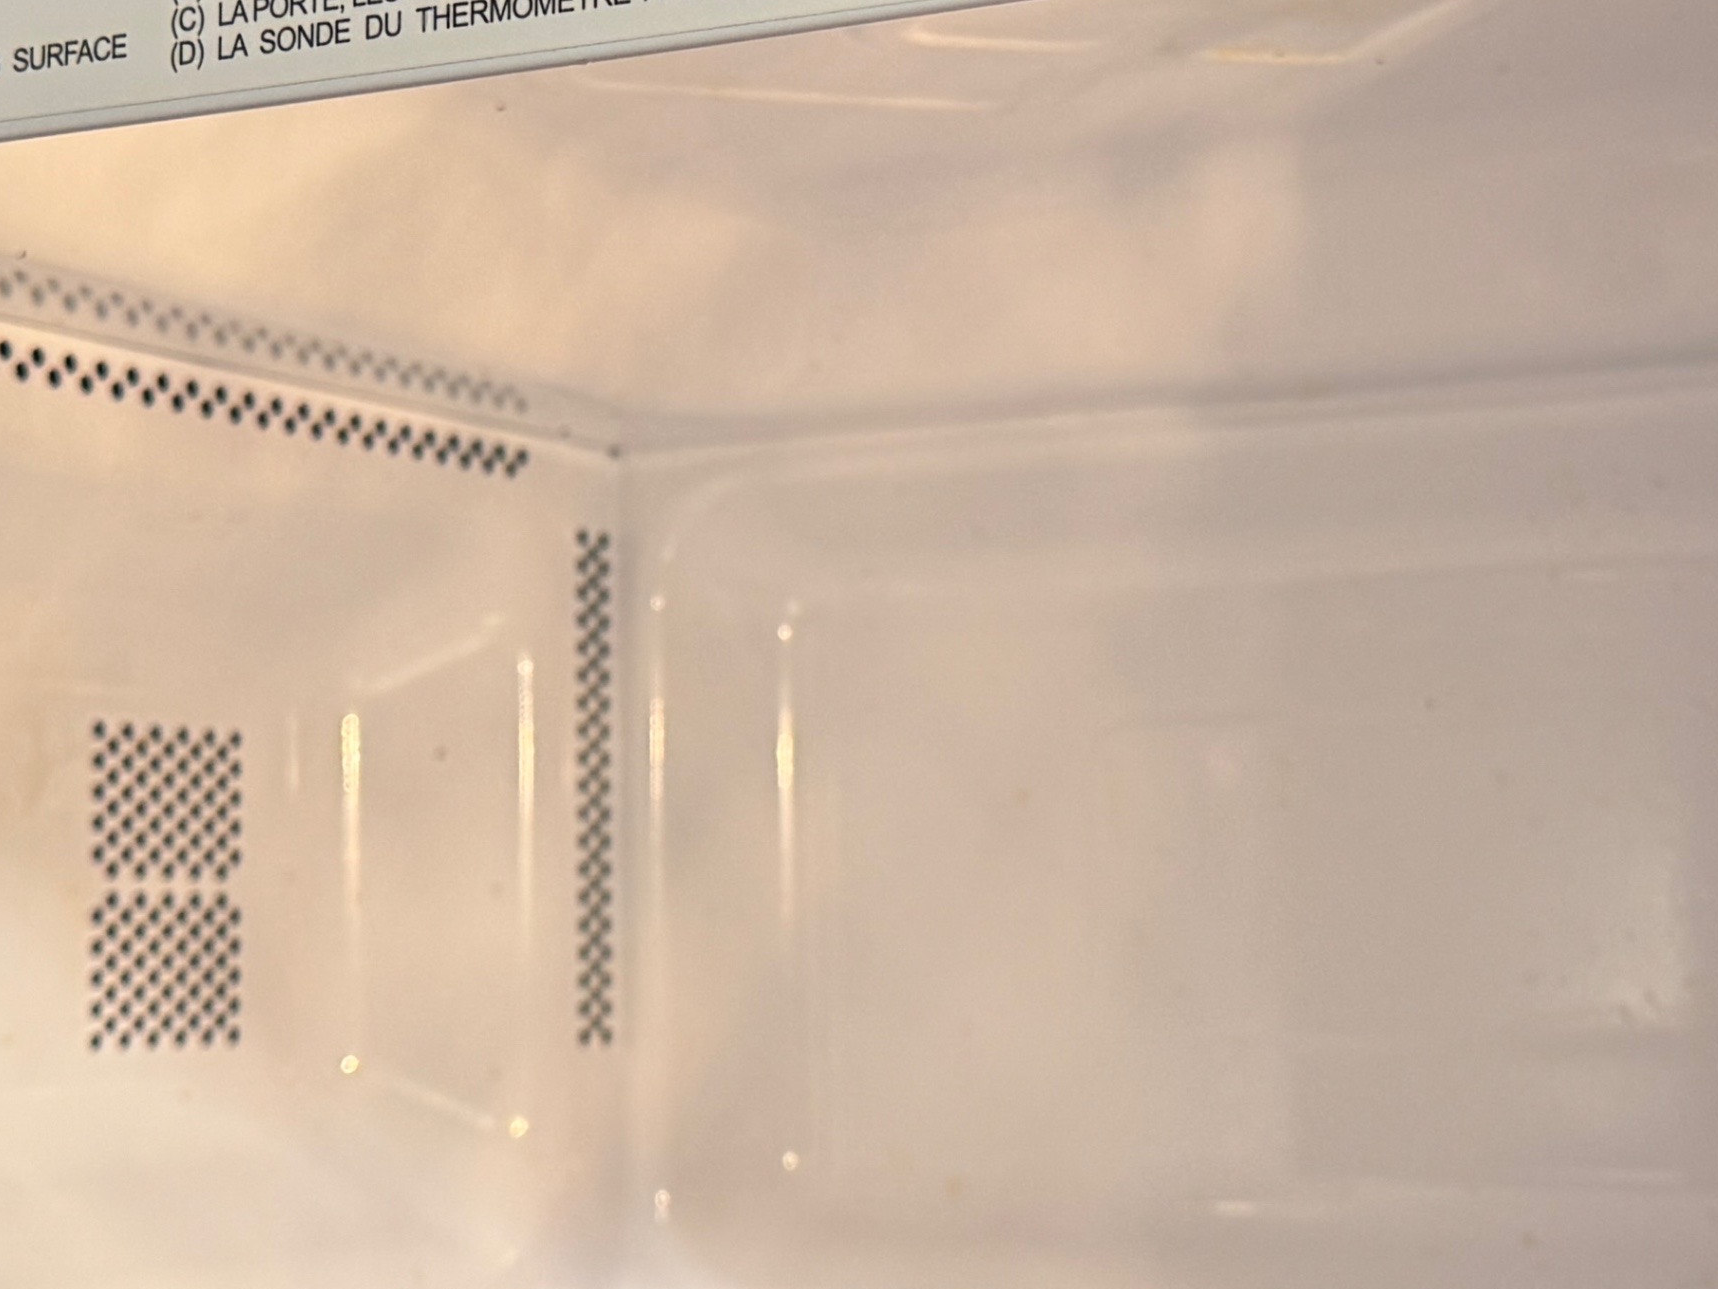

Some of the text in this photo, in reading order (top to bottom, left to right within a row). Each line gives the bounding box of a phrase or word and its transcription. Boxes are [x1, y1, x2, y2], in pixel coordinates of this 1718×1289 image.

[170, 6, 205, 40] (C)
[170, 38, 205, 74] (D)
[217, 32, 249, 61] LA
[259, 17, 351, 55] SONDE
[364, 9, 402, 41] DU
[12, 32, 128, 73] SURFACE
